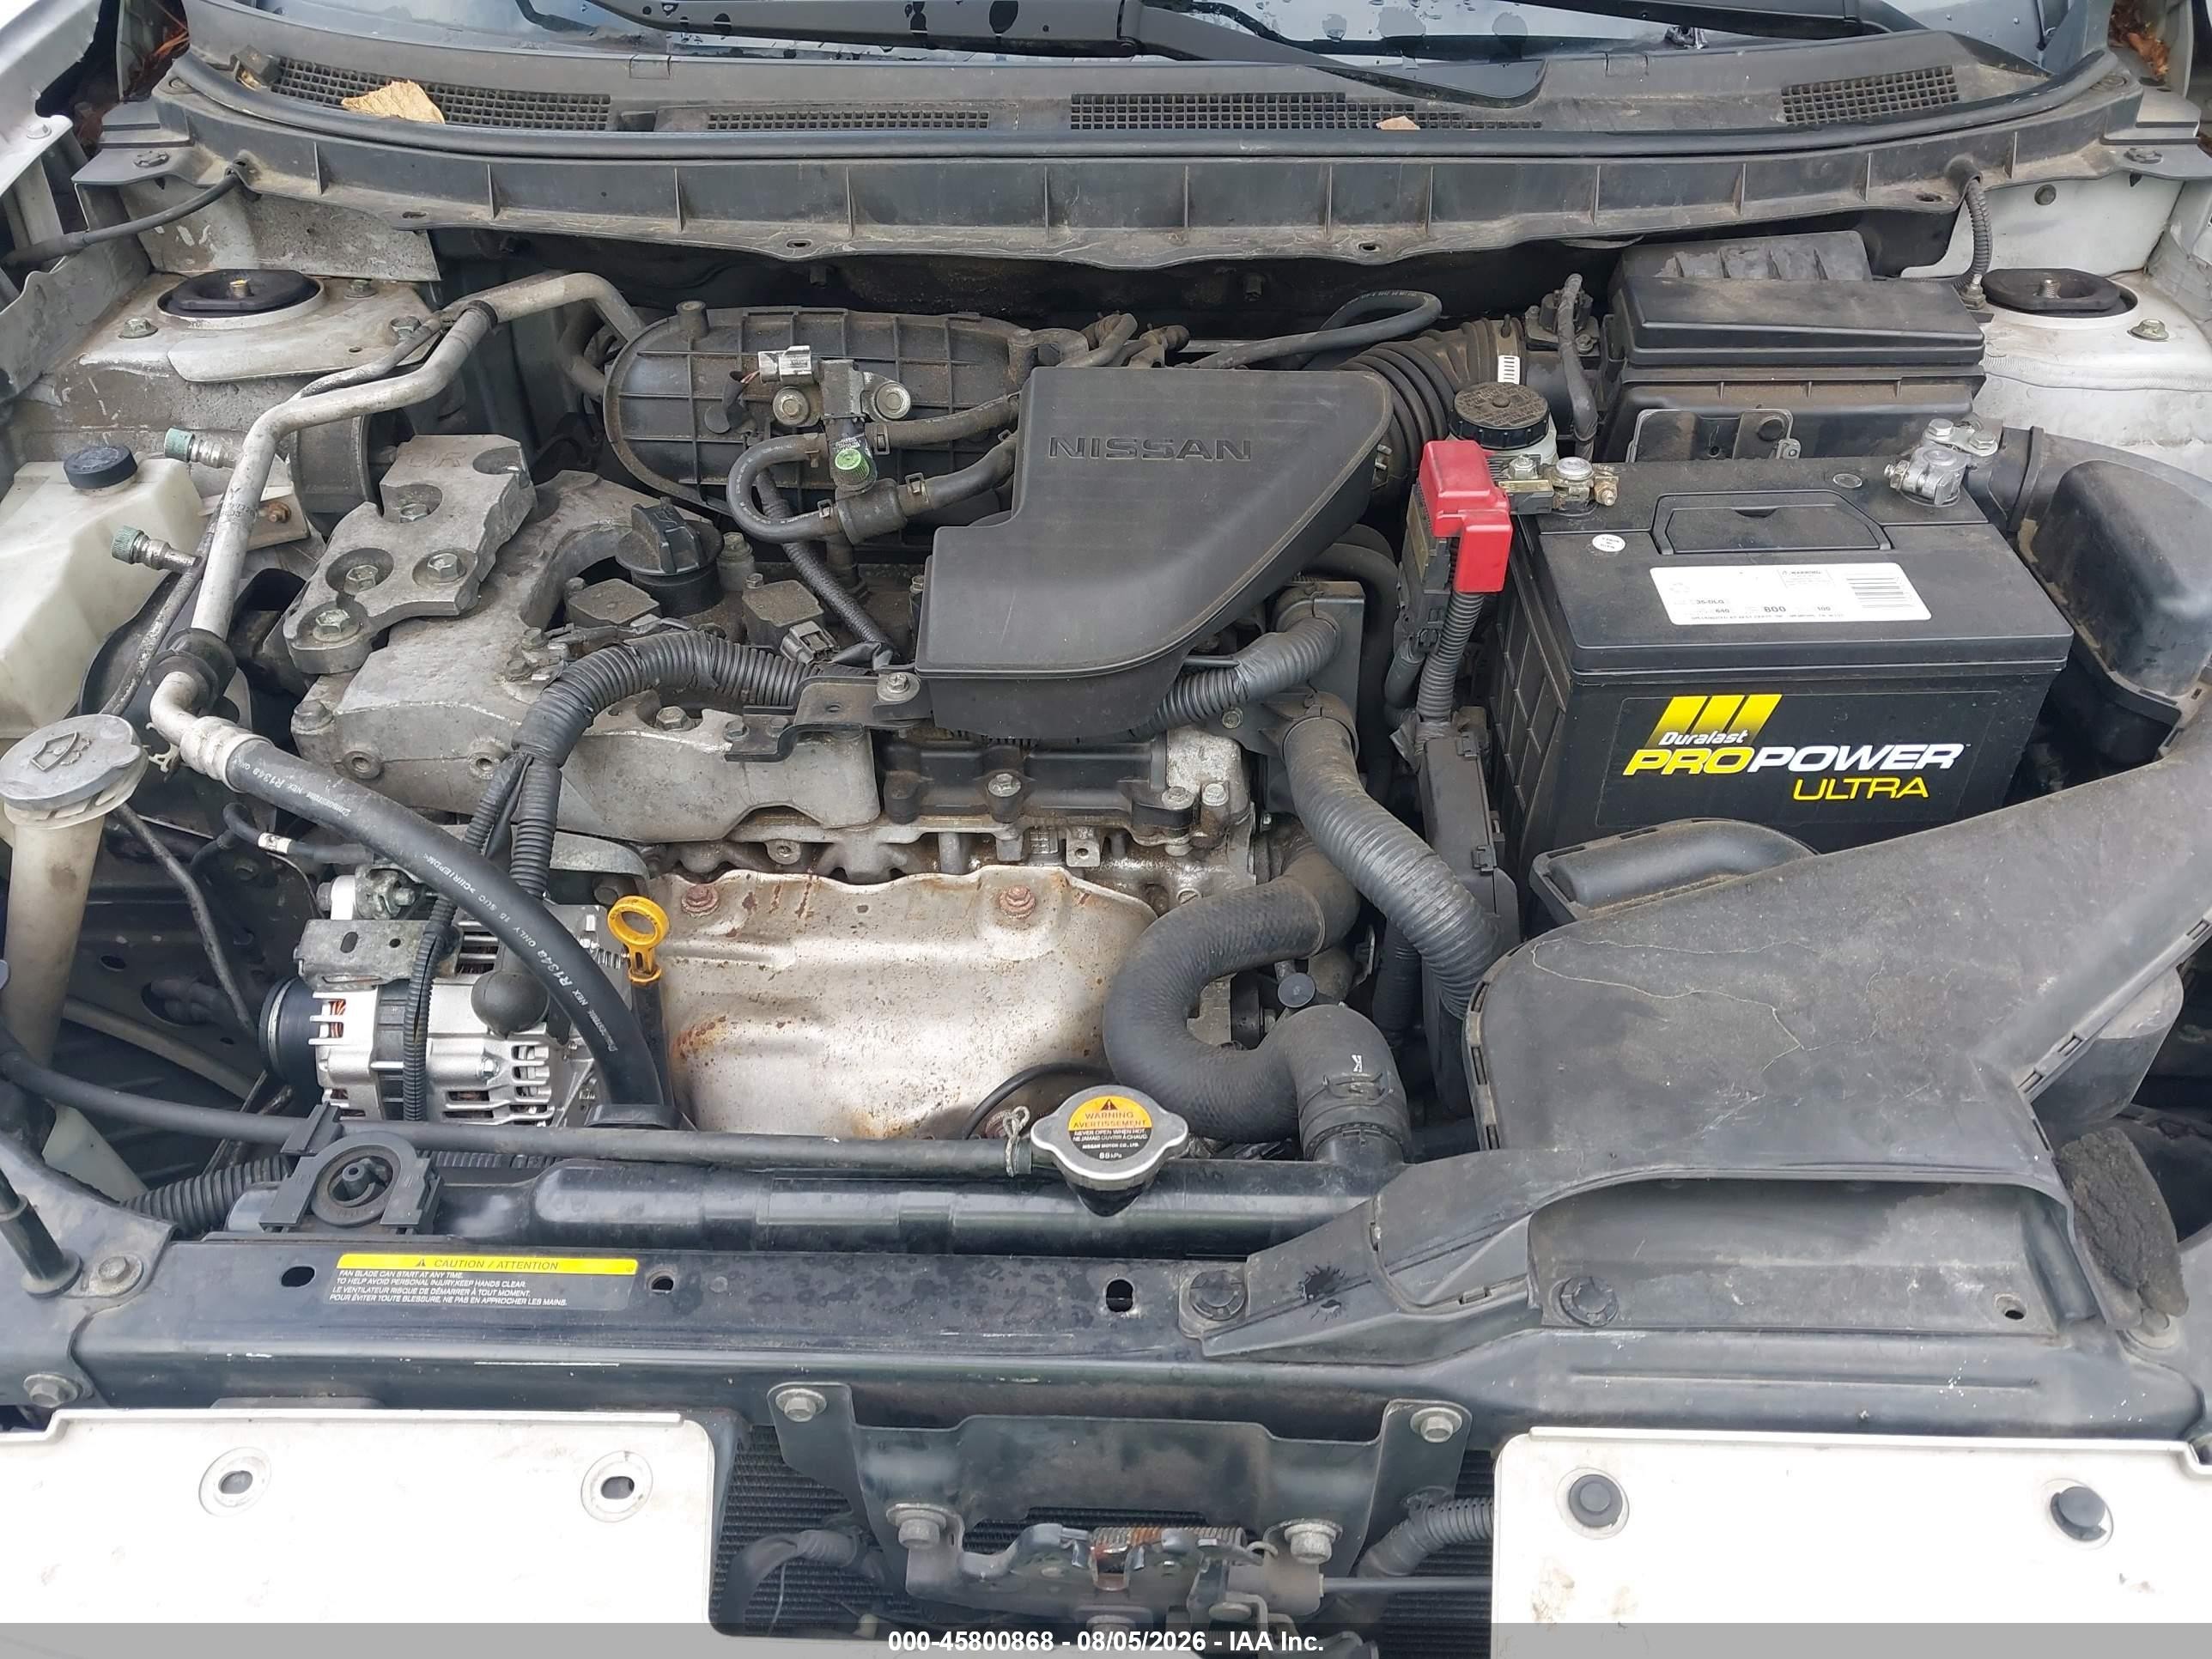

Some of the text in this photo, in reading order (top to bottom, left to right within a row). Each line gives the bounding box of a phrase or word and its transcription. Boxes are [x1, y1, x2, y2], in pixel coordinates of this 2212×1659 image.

[1049, 436, 1251, 461] NISSAN
[1658, 729, 1748, 746] Duralast
[1792, 776, 1929, 801] ULTRA
[478, 895, 498, 911] SUC
[513, 927, 537, 947] ONLY
[537, 949, 574, 988] R134a
[572, 988, 589, 1006] NEX
[1073, 1120, 1146, 1128] AVERTISSEMENT
[434, 1259, 485, 1268] CAUTION
[496, 1261, 558, 1270] ATTENTION
[351, 1292, 376, 1301] ÉVITER
[429, 1287, 471, 1296] DÉMARRER
